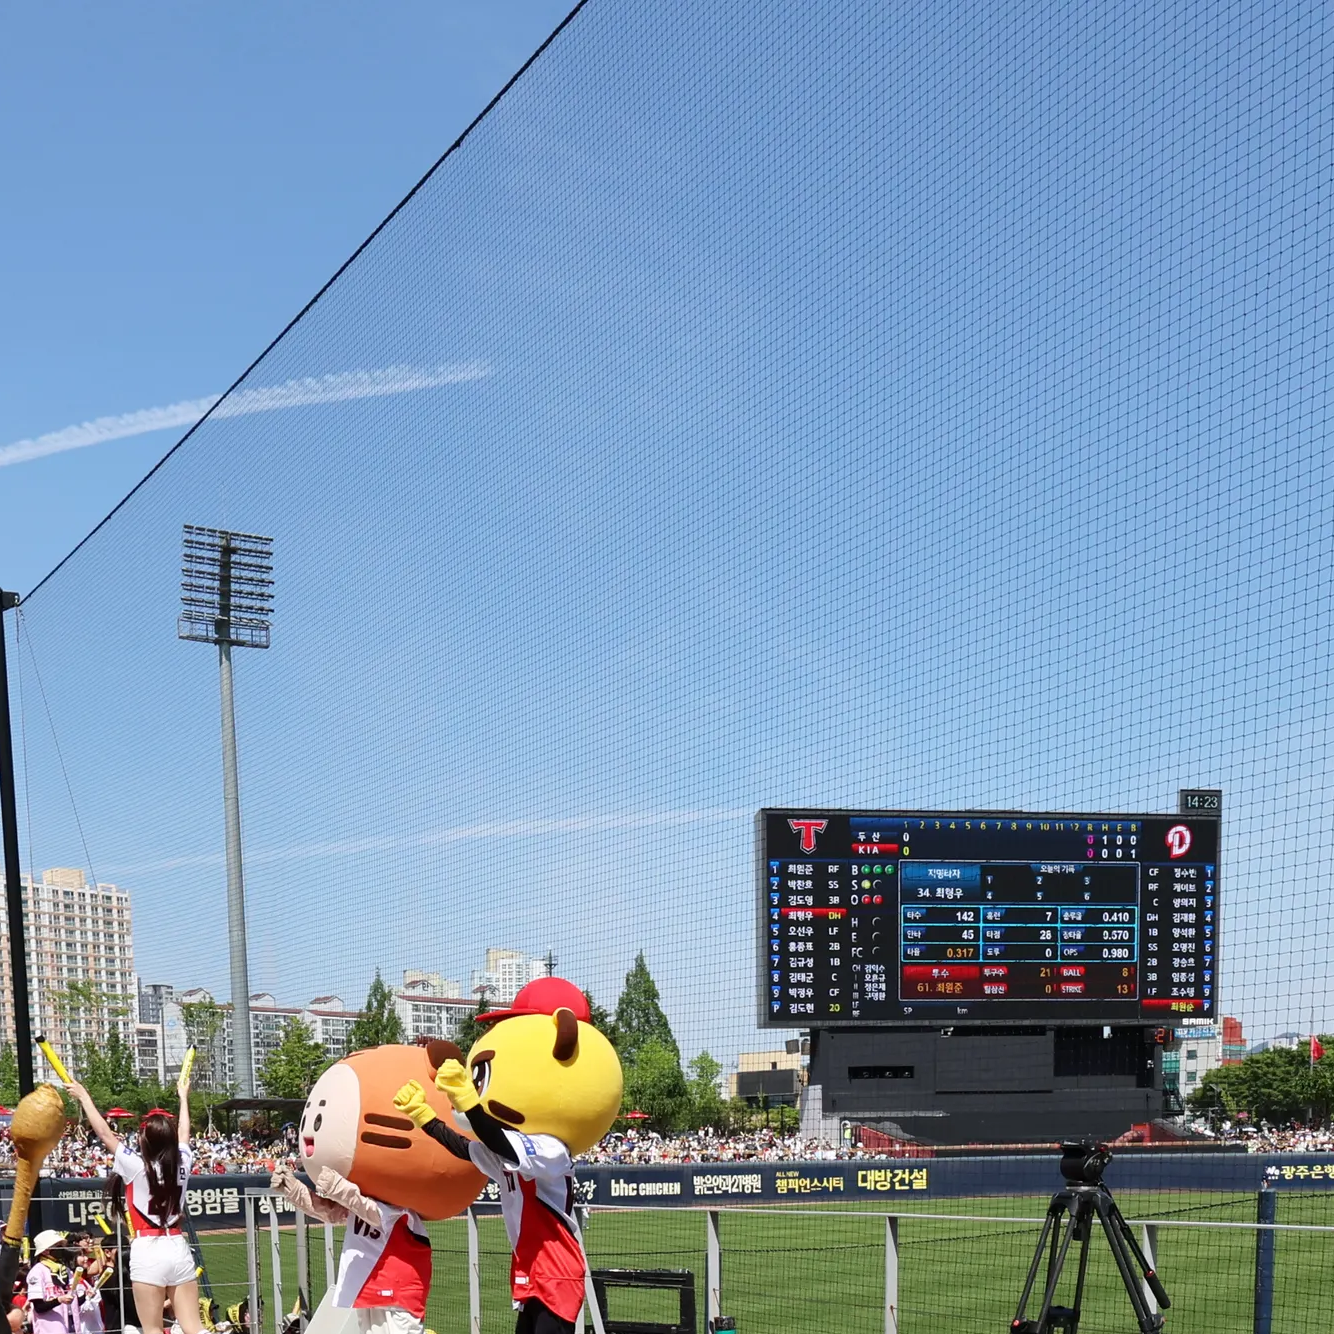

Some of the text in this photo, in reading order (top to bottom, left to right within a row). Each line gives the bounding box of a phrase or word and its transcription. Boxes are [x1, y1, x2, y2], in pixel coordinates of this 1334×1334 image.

[1187, 796, 1218, 808] 14:23
[903, 833, 909, 841] 0
[1087, 835, 1093, 844] 0
[1102, 835, 1107, 844] 1
[1117, 836, 1122, 845] 0
[1131, 836, 1136, 845] 0
[859, 846, 1135, 858] KIA 0 0 0 0 1
[852, 866, 858, 875] B
[1149, 868, 1159, 876] CF
[828, 881, 839, 889] SS
[852, 880, 858, 890] S
[1148, 883, 1159, 891] RF
[829, 896, 839, 904] 3B
[851, 895, 858, 905] O
[956, 911, 974, 921] 142
[1046, 912, 1052, 921] 7
[1103, 912, 1129, 922] 0.410
[852, 918, 858, 927] H
[829, 927, 839, 935] LF
[962, 930, 974, 939] 45
[1040, 930, 1052, 940] 28
[1103, 931, 1129, 940] 0.570
[1148, 928, 1158, 936] 1B
[852, 933, 857, 942] E
[829, 943, 840, 951] 2B
[1148, 943, 1158, 951] SS
[851, 948, 863, 958] FC
[947, 948, 974, 957] 0.317
[1045, 949, 1052, 957] 0
[1103, 949, 1129, 958] 0.980
[830, 958, 840, 966] 1B
[1147, 958, 1158, 966] 2B
[832, 973, 837, 981] C
[1040, 968, 1051, 977] 21
[1063, 969, 1081, 977] BALL
[1122, 968, 1128, 977] 8
[1147, 973, 1157, 981] 3B
[1045, 985, 1052, 993] 0
[1117, 985, 1128, 993] 13
[829, 1004, 840, 1012] 20
[1204, 1003, 1209, 1011] P
[858, 1168, 928, 1190] 대방건설
[611, 1179, 637, 1197] bhc
[639, 1182, 680, 1196] CHICKEN
[776, 1177, 844, 1193] 챔피언스시티
[186, 1188, 240, 1215] 영암몰
